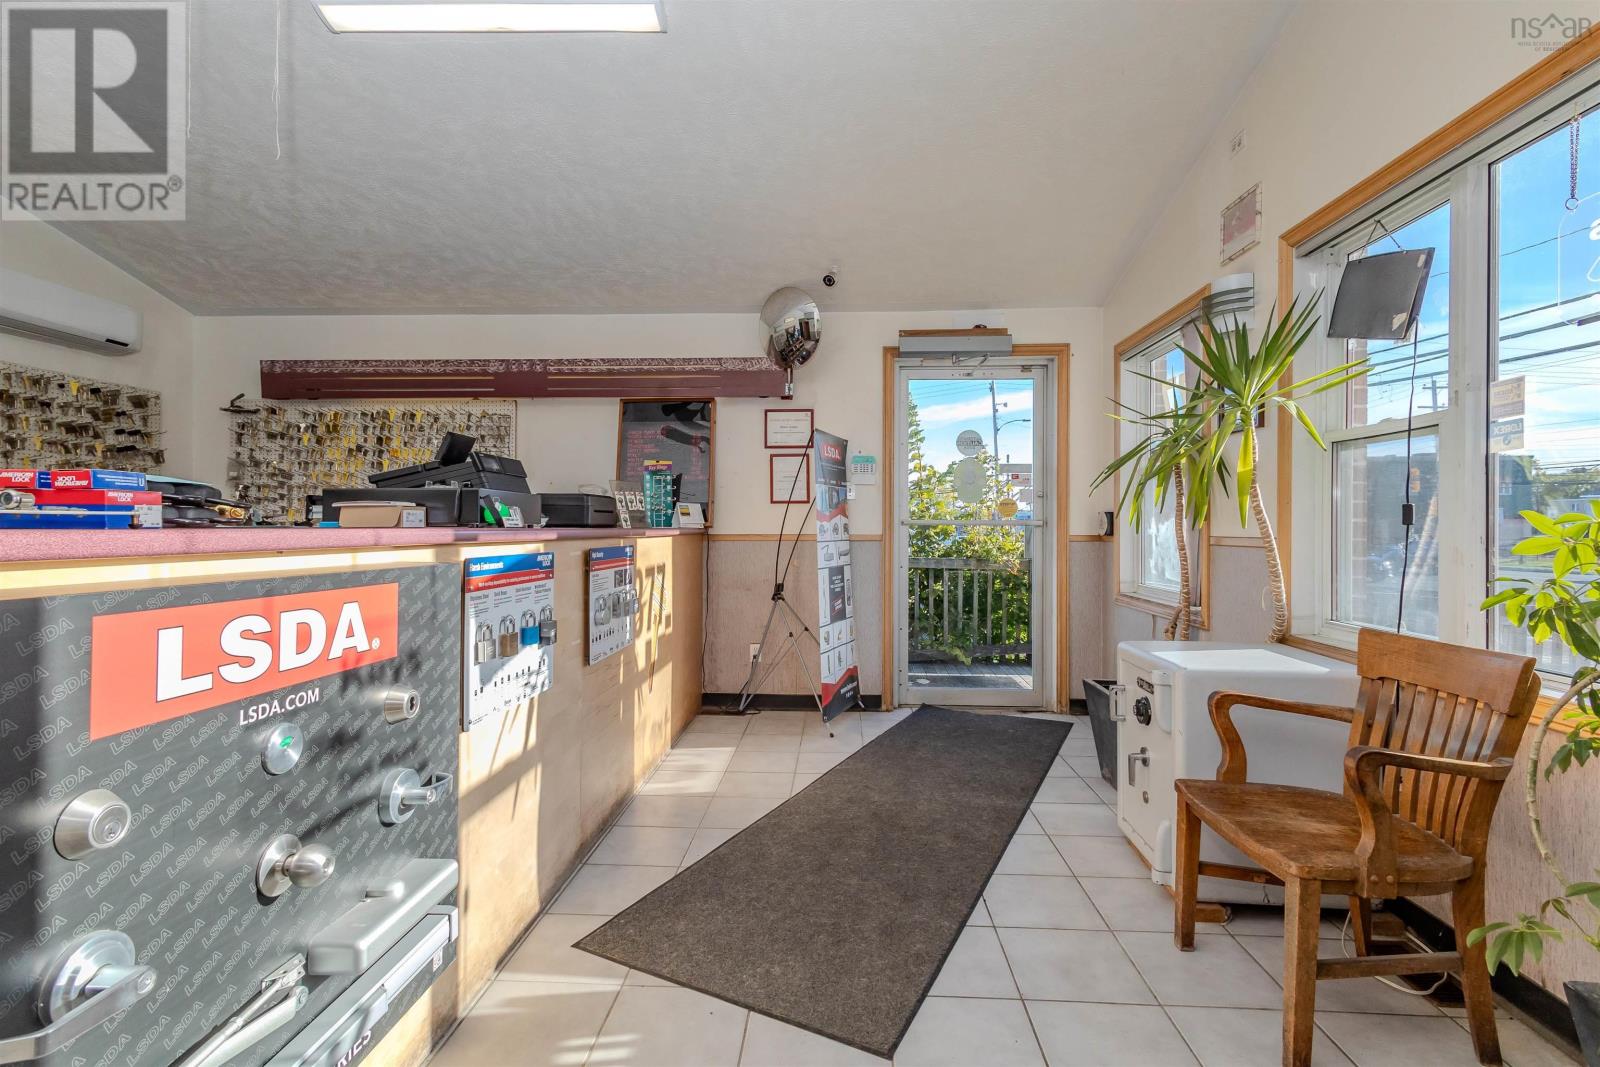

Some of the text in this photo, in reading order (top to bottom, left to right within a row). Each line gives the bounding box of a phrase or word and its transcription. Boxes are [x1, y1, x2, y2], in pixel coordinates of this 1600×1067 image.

[824, 444, 841, 460] LSDA
[92, 588, 136, 613] LSD
[136, 585, 181, 610] SDA
[16, 618, 74, 657] LSDA
[68, 635, 91, 660] LS
[40, 669, 91, 710] LSDA
[240, 688, 320, 726] LSDA.COM
[13, 717, 71, 761] LSDA
[66, 732, 91, 758] LS
[109, 722, 151, 756] LSD
[152, 714, 195, 751] LSDA
[189, 714, 227, 748] LSDA
[0, 767, 48, 809] SDA
[100, 760, 138, 790] SDA
[131, 757, 176, 797] LSDA
[170, 754, 210, 792] LSDA
[205, 752, 242, 787] LSDA
[187, 792, 226, 830] LSDA
[220, 788, 255, 824] LSDA
[251, 784, 282, 818] LSDA
[278, 780, 306, 812] LSDA
[128, 804, 154, 830] DA
[150, 798, 193, 838] LSDA
[11, 825, 53, 866] LSD
[168, 836, 208, 876] LSDA
[203, 829, 240, 867] LSDA
[85, 852, 134, 898] LSDA
[129, 843, 174, 887] LSDA
[219, 863, 253, 903] LSDA
[0, 870, 44, 911] SDA
[36, 862, 90, 911] LSDA
[148, 881, 190, 926] LSDA
[185, 872, 224, 913] LSDA
[73, 902, 114, 937] SDA
[116, 892, 152, 930] SDA
[202, 906, 238, 949] LSDA
[234, 904, 262, 936] LSD
[138, 928, 173, 965] SDA
[166, 918, 206, 962] LSDA
[248, 928, 278, 968] LSDA
[184, 952, 222, 997] LSDA
[217, 939, 252, 982] LSDA
[146, 966, 188, 1014] LSDA
[200, 984, 236, 1031] LSDA
[164, 1000, 204, 1049] LSDA
[98, 1034, 132, 1067] SDA
